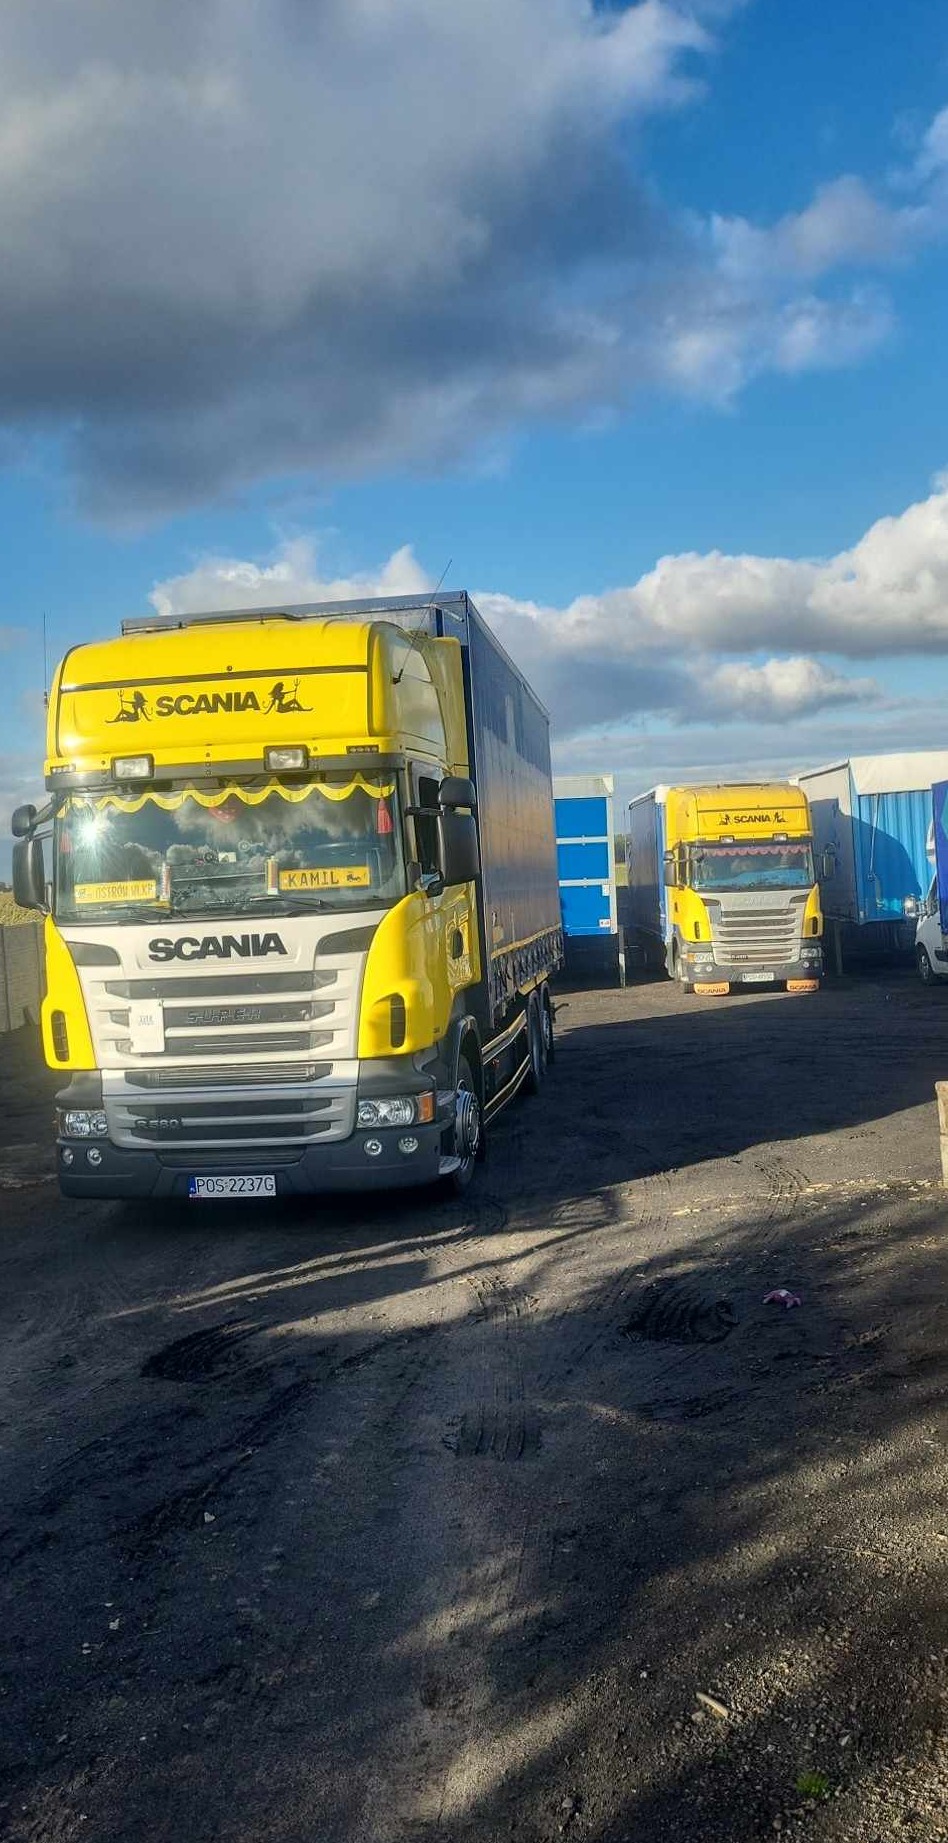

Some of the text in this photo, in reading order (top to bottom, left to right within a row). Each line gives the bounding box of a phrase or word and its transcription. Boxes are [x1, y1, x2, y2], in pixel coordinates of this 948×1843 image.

[155, 691, 260, 717] SCANIA
[733, 814, 771, 824] SCANIA
[287, 871, 340, 887] KAMIL
[148, 932, 288, 962] SCANIA
[698, 987, 727, 995] SCANIA
